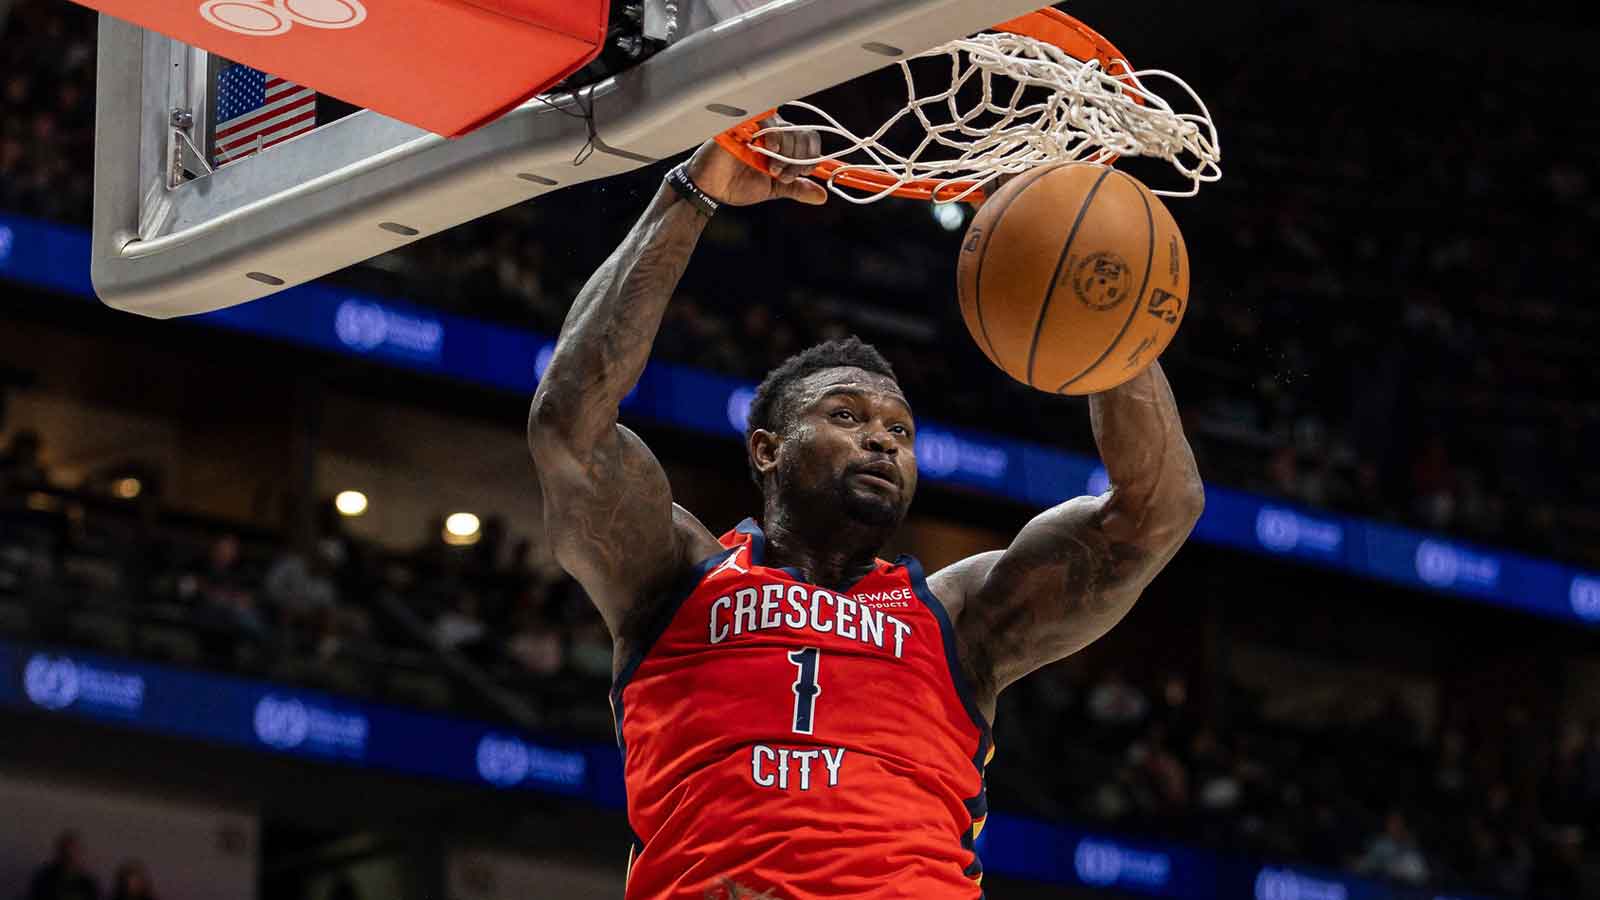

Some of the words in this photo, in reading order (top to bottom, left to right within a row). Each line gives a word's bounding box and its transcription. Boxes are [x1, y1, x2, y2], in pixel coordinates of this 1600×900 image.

[709, 583, 911, 658] CRESCENT
[787, 645, 820, 735] 1
[752, 744, 845, 790] CITY
